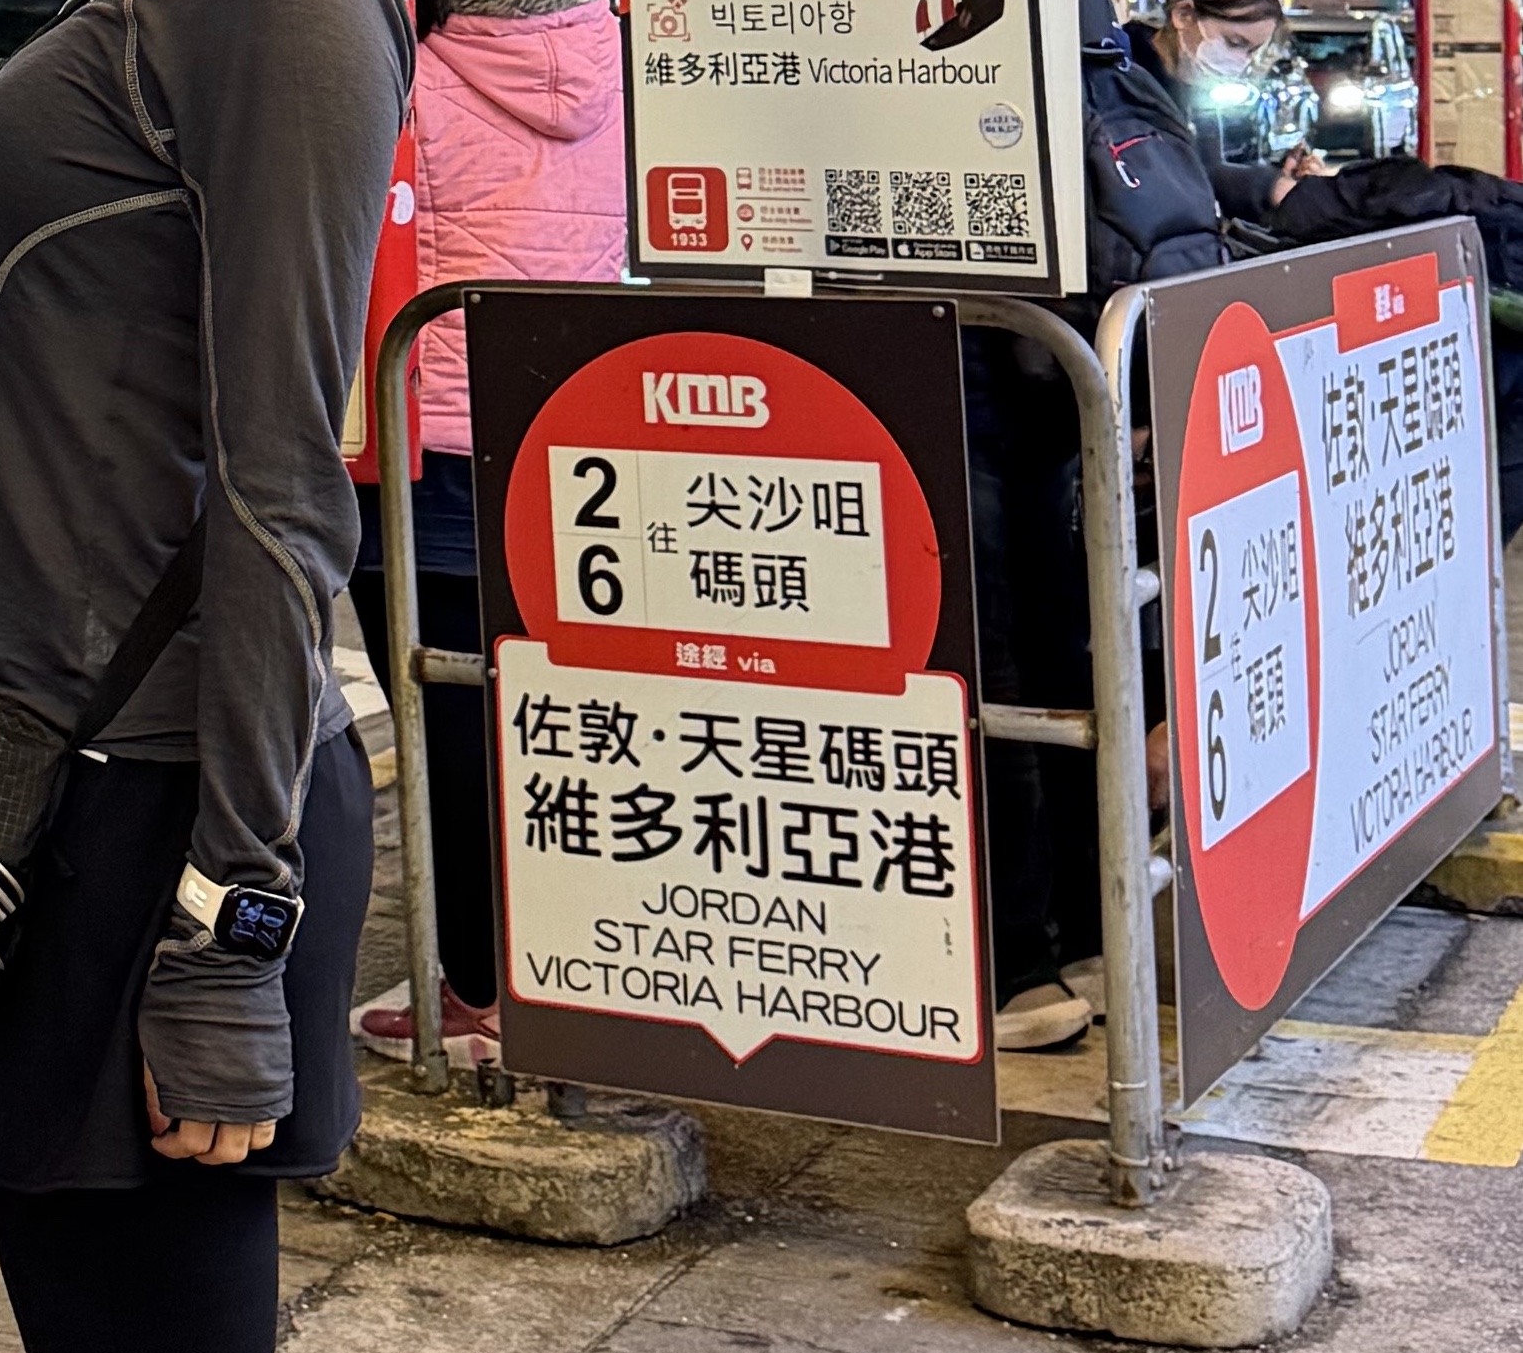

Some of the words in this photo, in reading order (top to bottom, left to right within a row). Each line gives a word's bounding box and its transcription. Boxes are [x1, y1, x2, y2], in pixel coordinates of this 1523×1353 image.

[710, 0, 856, 35] 빅토리아항
[644, 52, 801, 87] 維多利亞港
[808, 56, 893, 85] Victoria
[898, 56, 1002, 86] Harbour
[670, 232, 708, 247] 1933
[643, 371, 769, 429] KMB
[1217, 363, 1264, 457] KMB
[574, 456, 620, 531] 2
[687, 473, 870, 538] 尖沙咀
[647, 520, 678, 556] 往
[1345, 455, 1456, 617] 維多利亞港
[576, 542, 624, 617] 6
[689, 549, 811, 613] 碼頭
[1198, 527, 1223, 665] 2
[1240, 519, 1301, 633] 尖沙咀
[675, 642, 727, 673] 途經
[738, 651, 776, 675] via
[1383, 600, 1437, 684] JORDAN
[1245, 642, 1285, 745] 碼頭
[1370, 703, 1409, 765] STAR
[1409, 655, 1452, 733] FERRY
[1206, 687, 1227, 822] 6
[1350, 758, 1412, 854] VICTORIA
[1414, 708, 1473, 801] HARBOUR
[524, 772, 955, 899] 維多利亞港
[642, 882, 827, 936] JORDAN
[594, 919, 714, 966] STAR
[729, 938, 882, 986] FERRY
[526, 952, 723, 1011] VICTORIA
[739, 980, 961, 1043] HARBOUR
